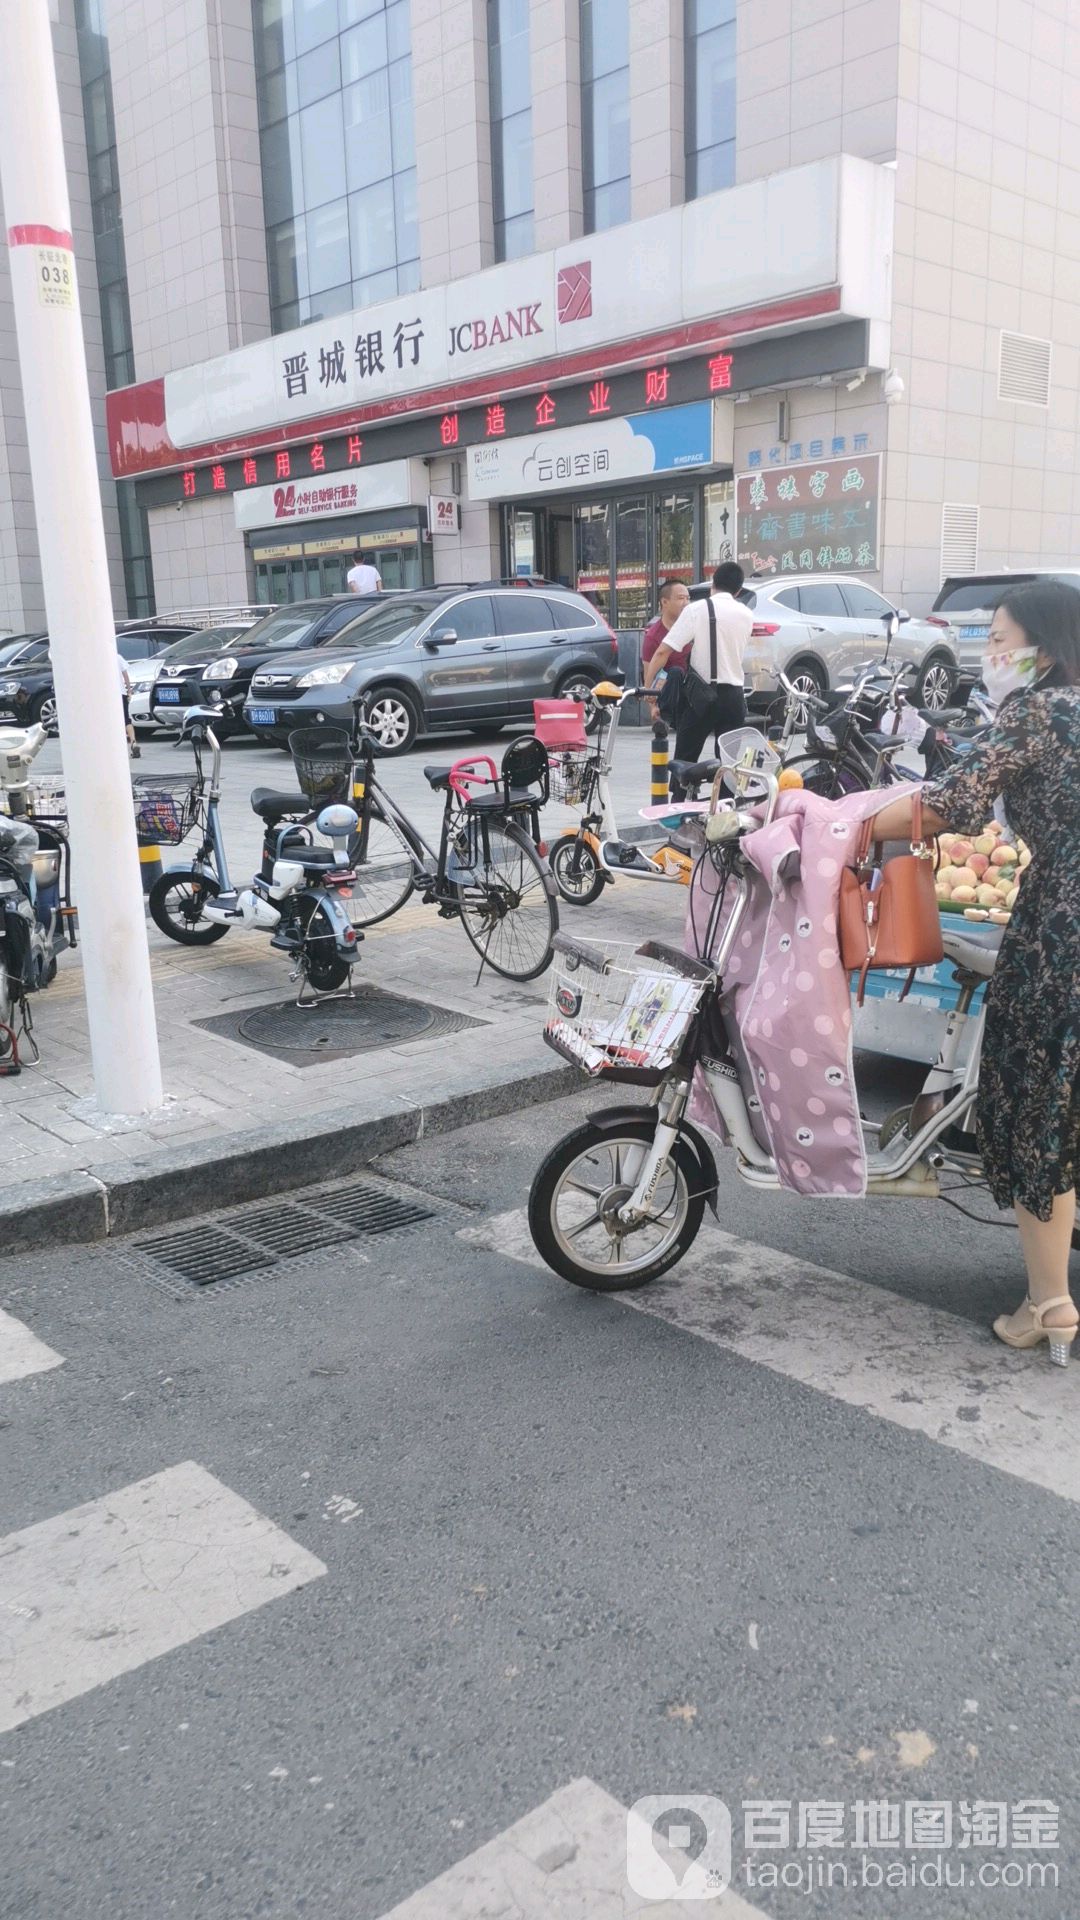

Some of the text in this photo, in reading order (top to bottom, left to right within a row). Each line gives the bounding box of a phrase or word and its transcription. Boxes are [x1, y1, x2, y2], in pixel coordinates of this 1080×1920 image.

[41, 266, 70, 285] 038
[282, 302, 543, 398] 晋城银行 JCBANK
[183, 353, 733, 496] 打造信用名片 创造企业财富
[537, 449, 610, 482] 云创空间
[297, 483, 358, 506] 小时自助银行服务
[437, 501, 453, 518] 24
